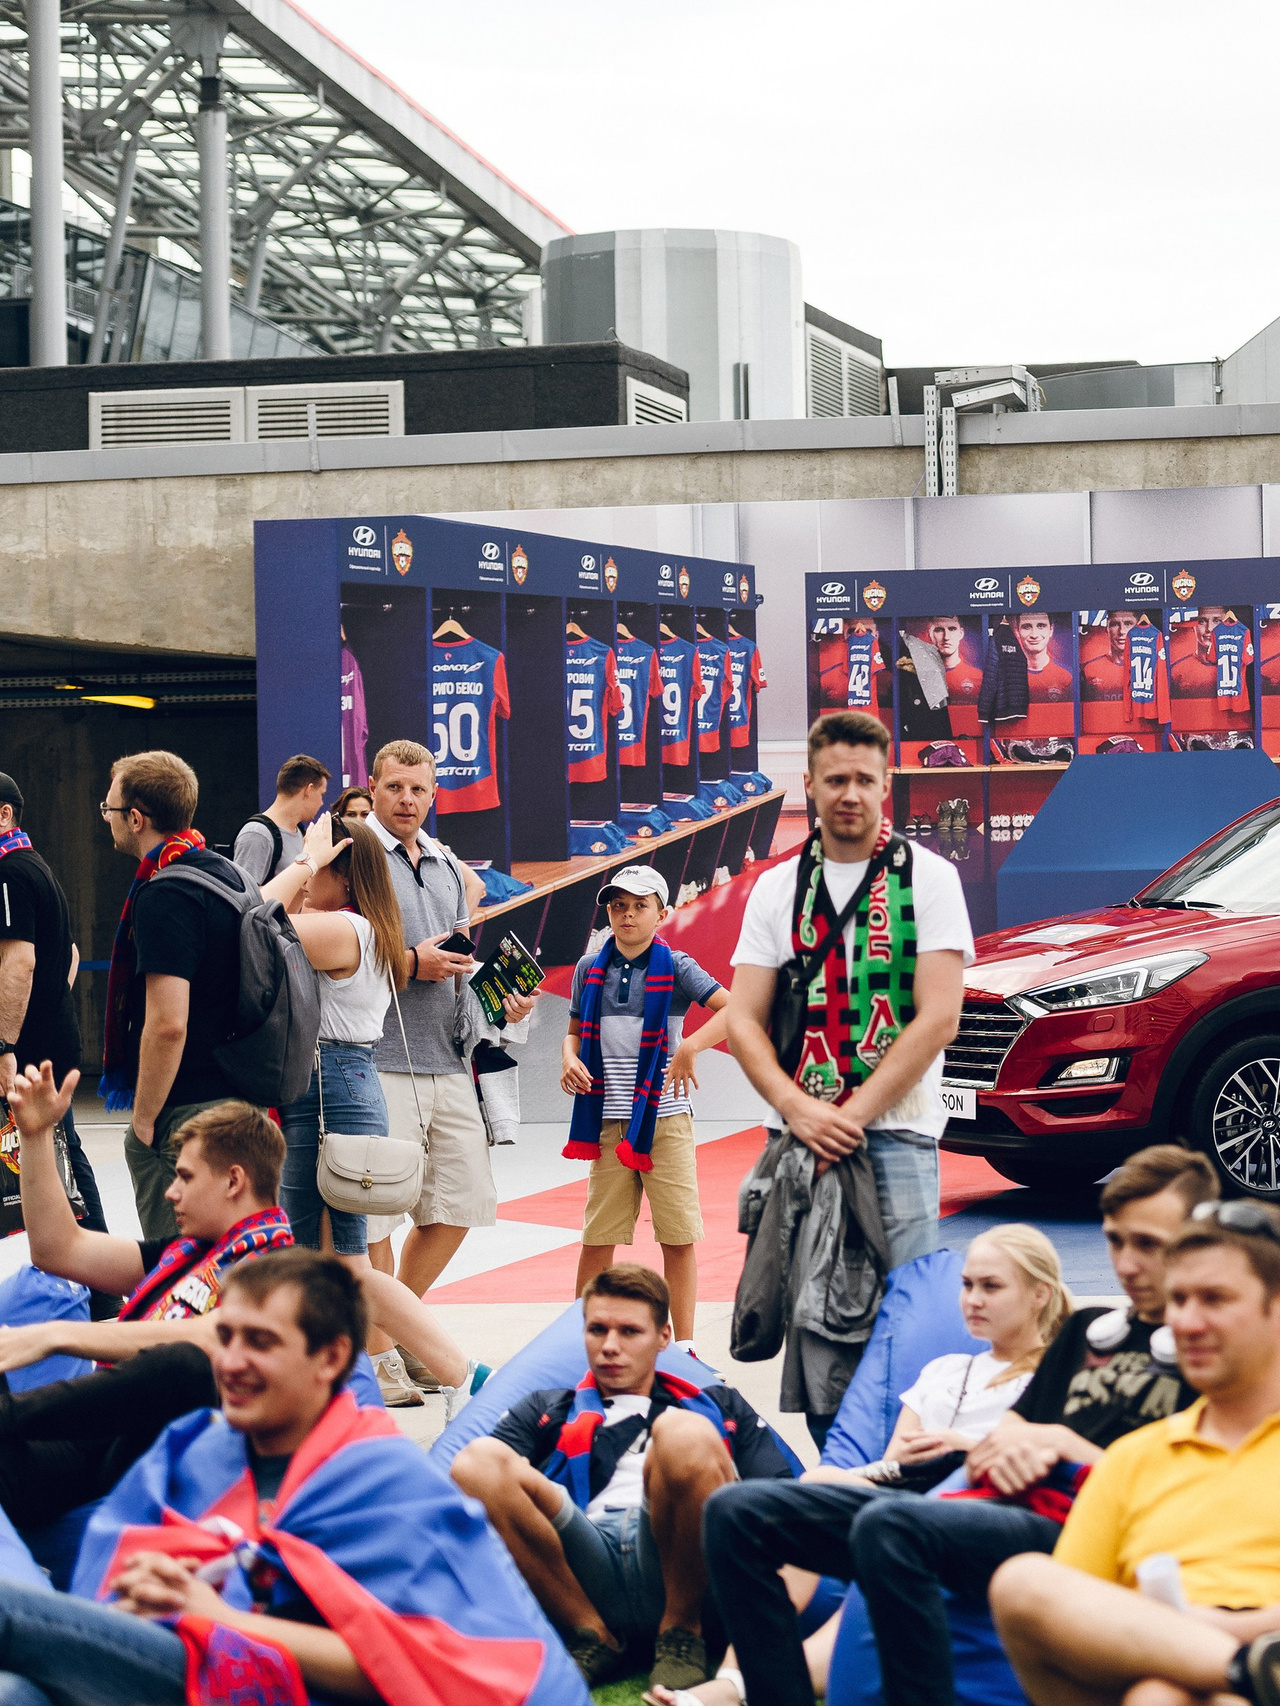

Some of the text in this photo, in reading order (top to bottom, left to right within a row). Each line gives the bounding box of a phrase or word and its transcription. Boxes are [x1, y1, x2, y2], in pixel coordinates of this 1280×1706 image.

[348, 547, 382, 559] HYUNDAI
[478, 561, 504, 571] HYUNDAI
[1131, 656, 1153, 691] 14
[662, 682, 681, 726] 9
[433, 702, 480, 764] 50
[171, 1275, 212, 1315] ЦСКА
